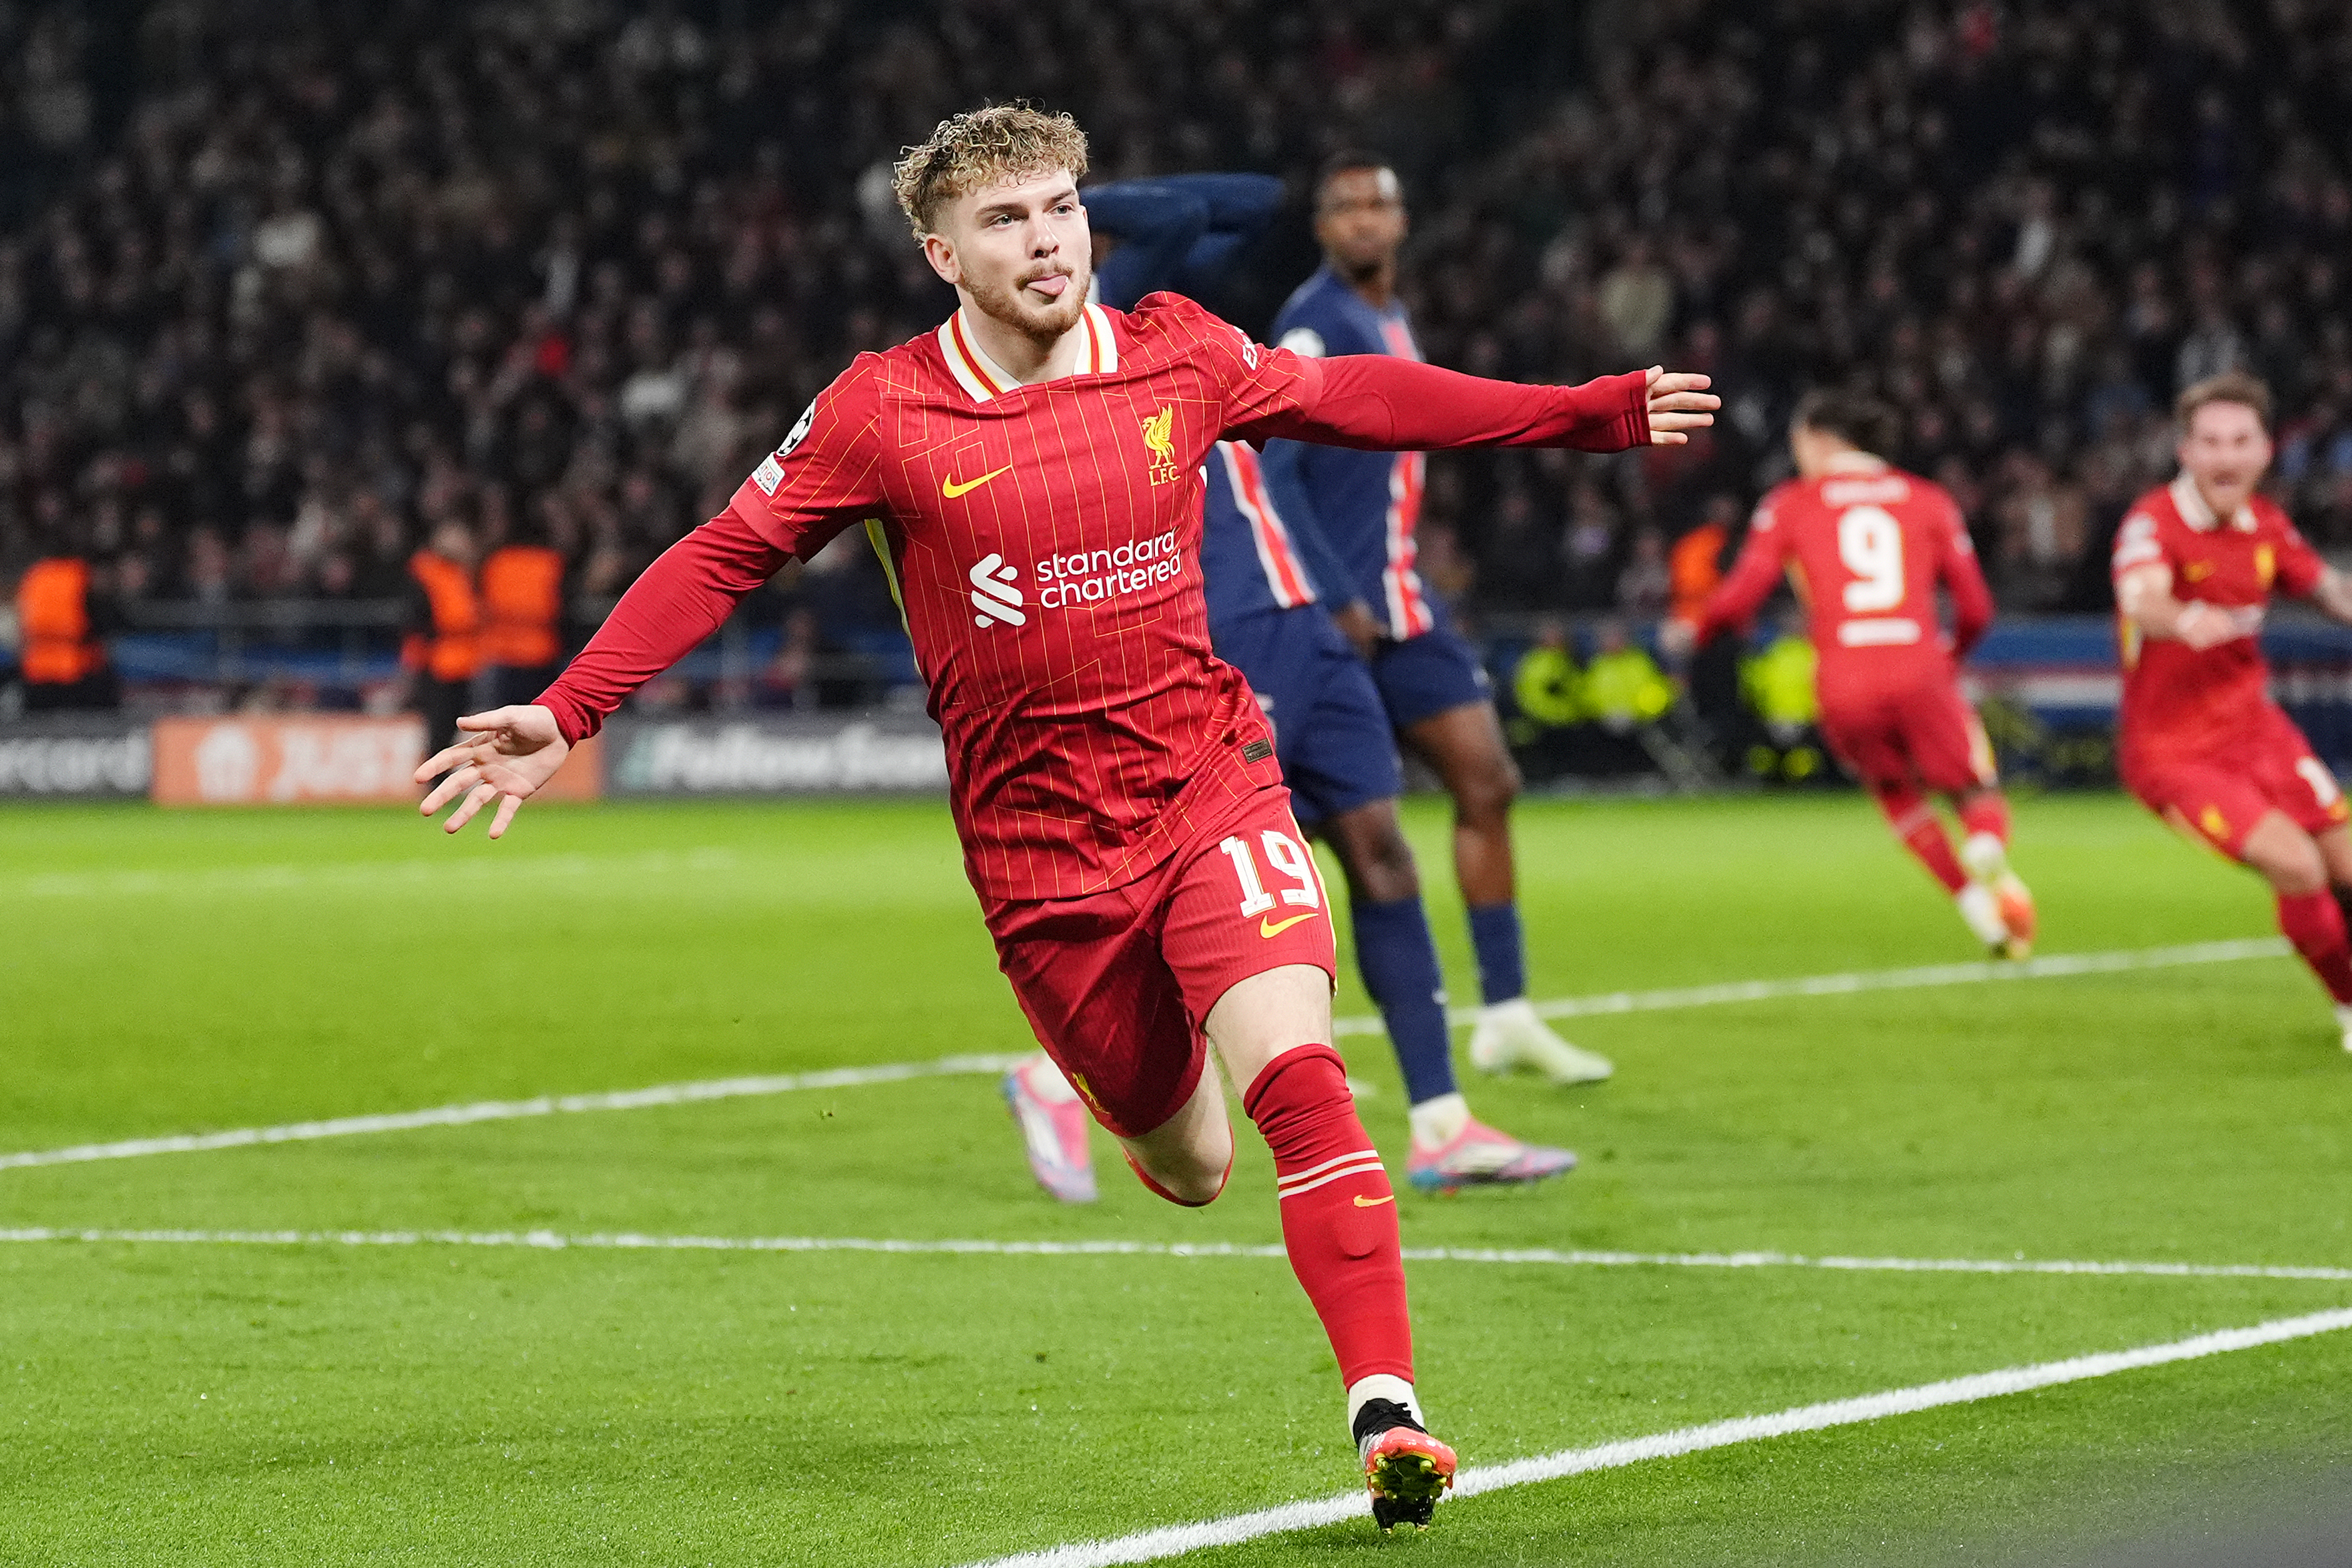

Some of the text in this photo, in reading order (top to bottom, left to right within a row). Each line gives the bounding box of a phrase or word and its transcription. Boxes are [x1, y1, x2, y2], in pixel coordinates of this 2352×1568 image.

[1036, 525, 1178, 582] standard
[1040, 548, 1182, 609] chartered
[1837, 505, 1905, 613] 9
[1219, 830, 1320, 918] 19
